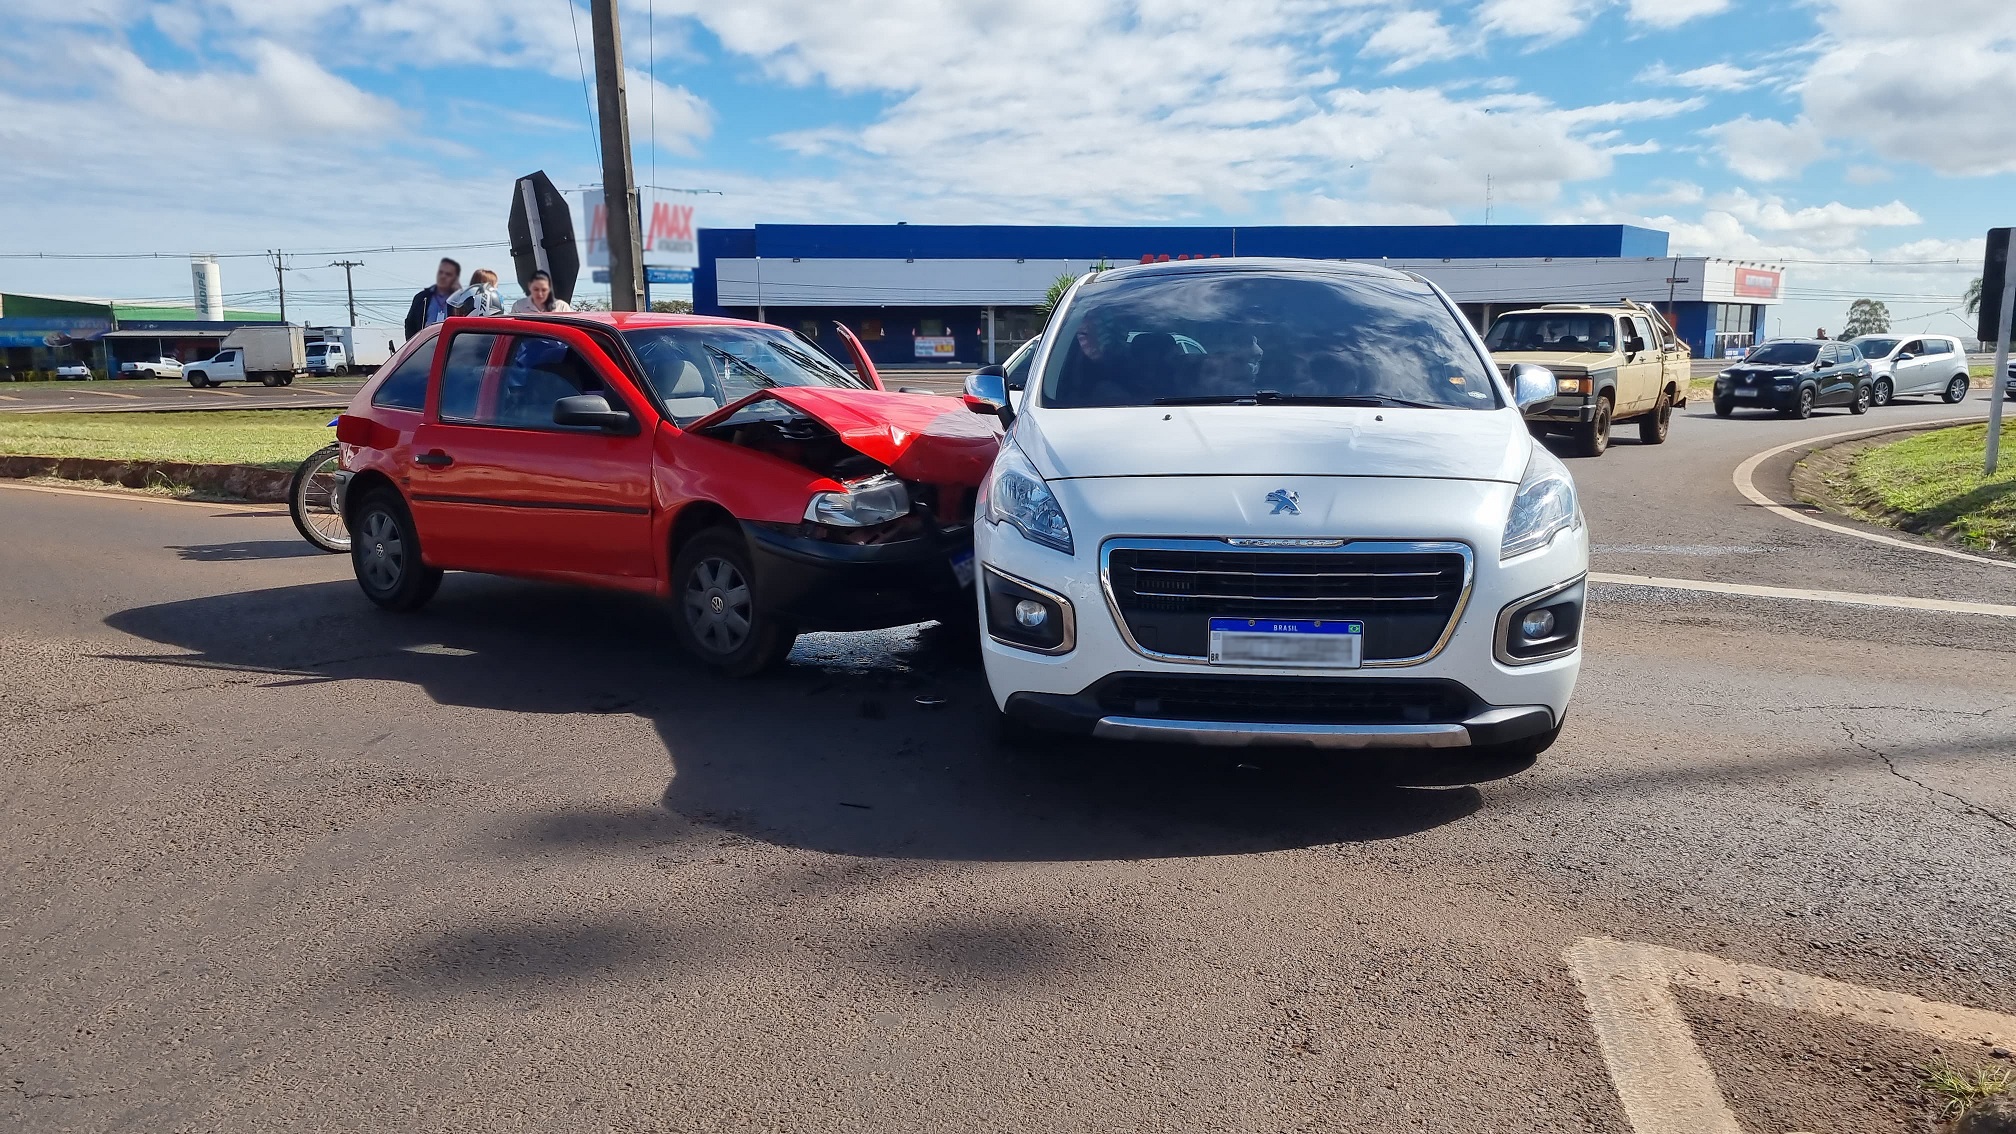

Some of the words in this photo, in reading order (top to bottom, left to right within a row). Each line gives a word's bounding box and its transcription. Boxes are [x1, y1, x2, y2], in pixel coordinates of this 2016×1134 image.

[645, 202, 694, 251] MAX
[1273, 624, 1298, 632] BRASIL
[1210, 653, 1220, 662] BR
